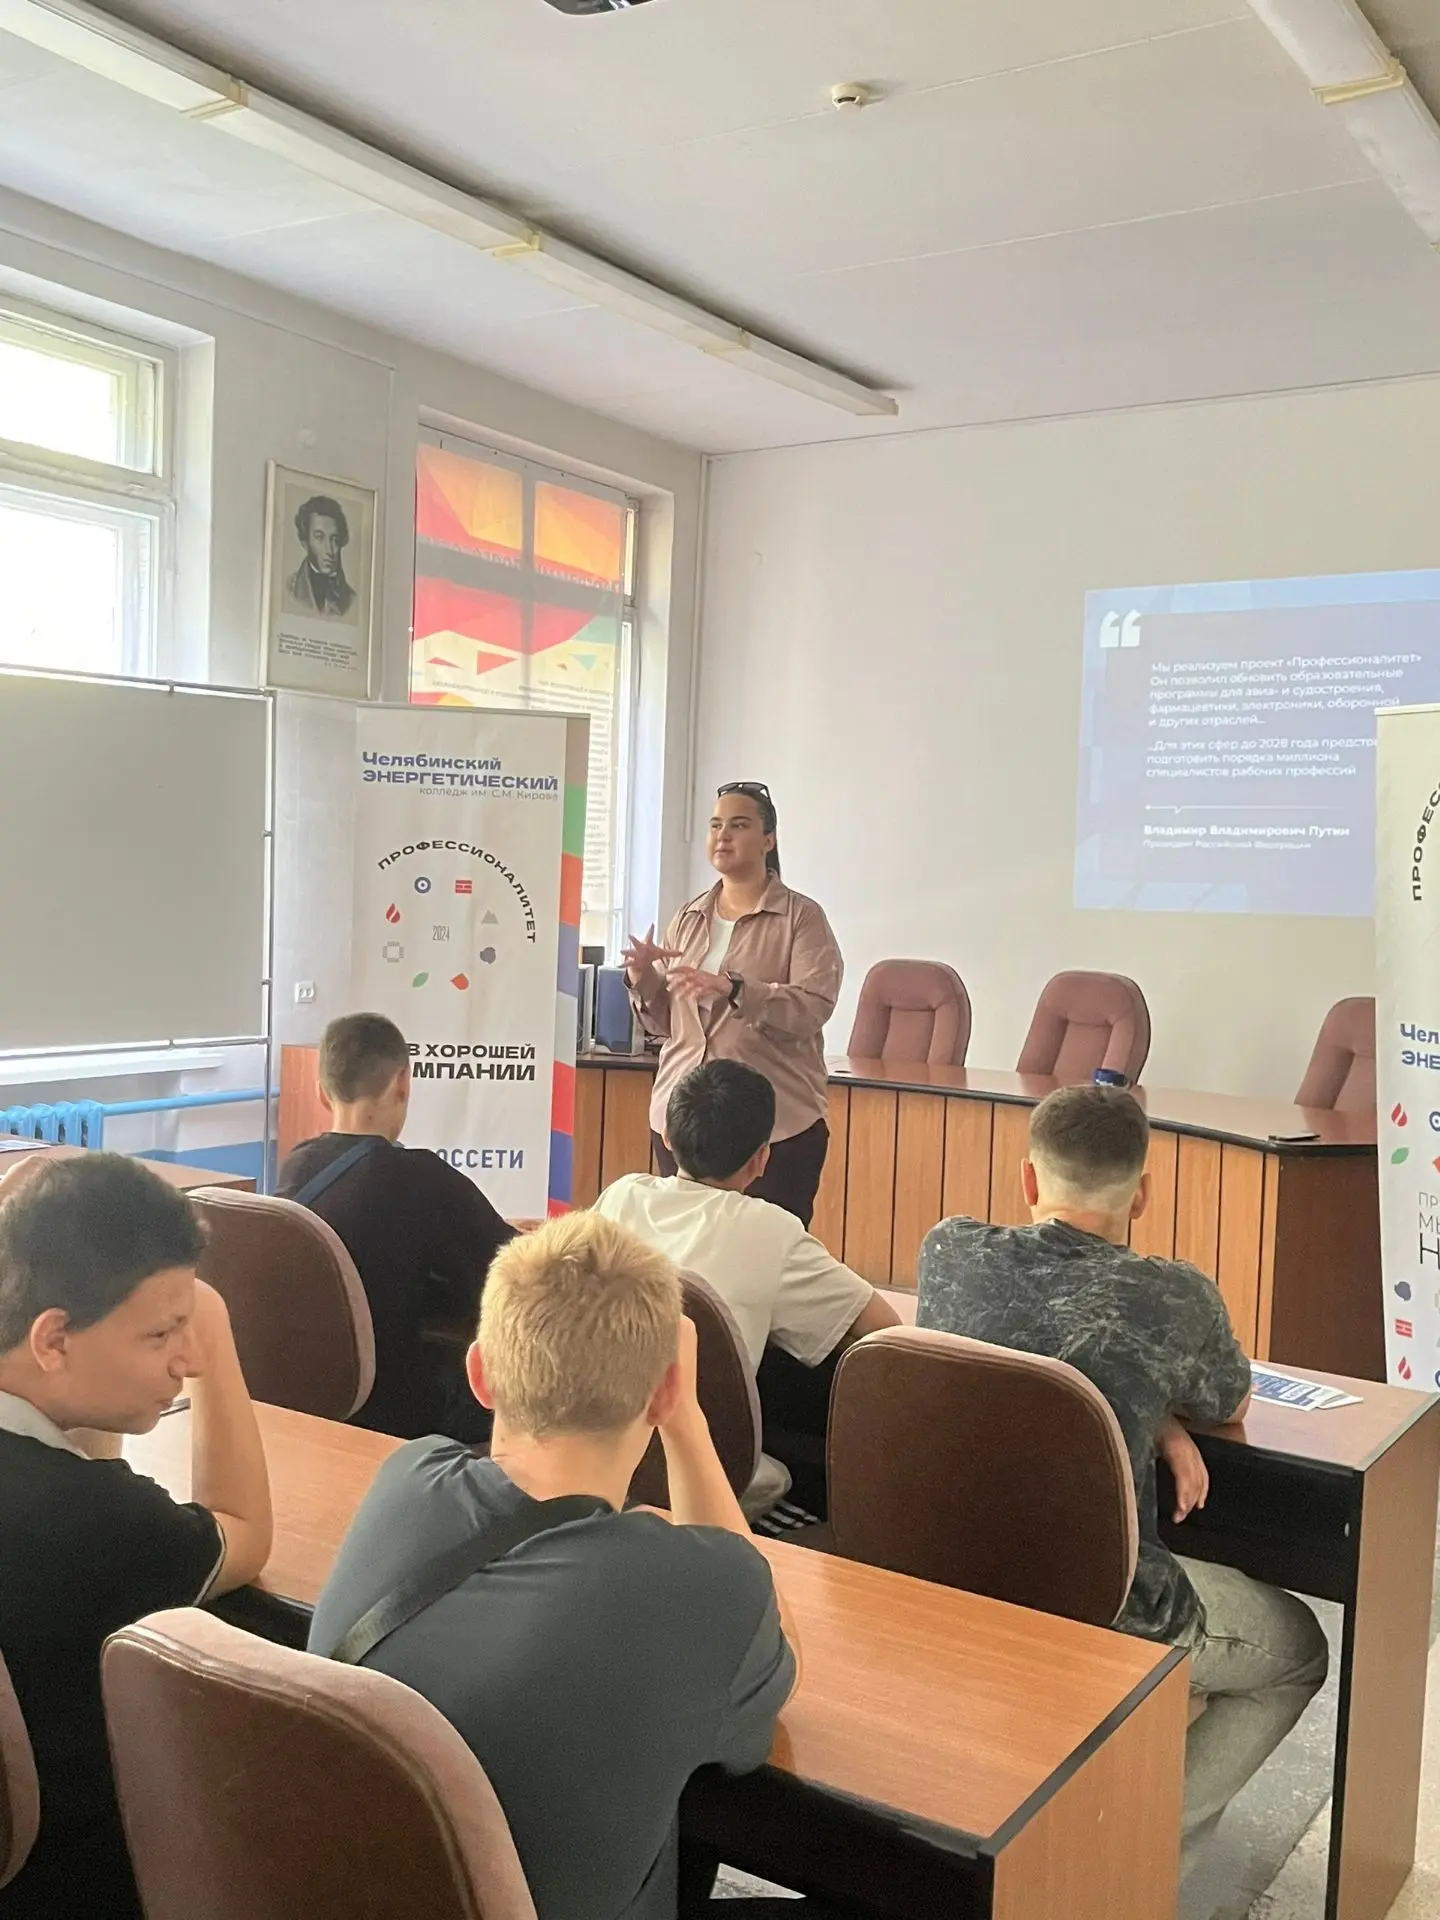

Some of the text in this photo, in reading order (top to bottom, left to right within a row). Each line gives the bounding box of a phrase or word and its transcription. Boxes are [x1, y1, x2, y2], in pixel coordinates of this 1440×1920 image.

[1151, 661, 1171, 673] Мы
[1172, 661, 1238, 673] реализуем
[1240, 658, 1284, 671] проект
[1150, 668, 1404, 686] Он позволил обновить образовательные
[1149, 689, 1219, 702] программы
[1219, 687, 1244, 698] для
[1281, 687, 1290, 696] и
[1292, 683, 1385, 698] судостроения,
[1327, 697, 1401, 710] оборонной
[1148, 718, 1157, 727] и
[1158, 717, 1200, 729] других
[1207, 739, 1240, 751] сфер
[1240, 740, 1258, 750] до
[1290, 739, 1320, 750] года
[362, 751, 502, 771] Челябинский
[1146, 753, 1341, 764] подготовить порядка миллиона
[1145, 764, 1357, 778] специалистов рабочих профессий
[362, 769, 559, 791] ЭНЕРГЕТИЧЕСКИЙ
[419, 786, 468, 798] колледж
[516, 790, 559, 802] Кирова
[1143, 825, 1351, 838] Владимир Владимирович Путин
[1412, 782, 1440, 901] ПРОФЕС
[377, 840, 536, 943] ПРОФЕССИОНАЛИТЕТ
[432, 925, 450, 941] 2024
[425, 1043, 536, 1060] ХОРОШЕЙ
